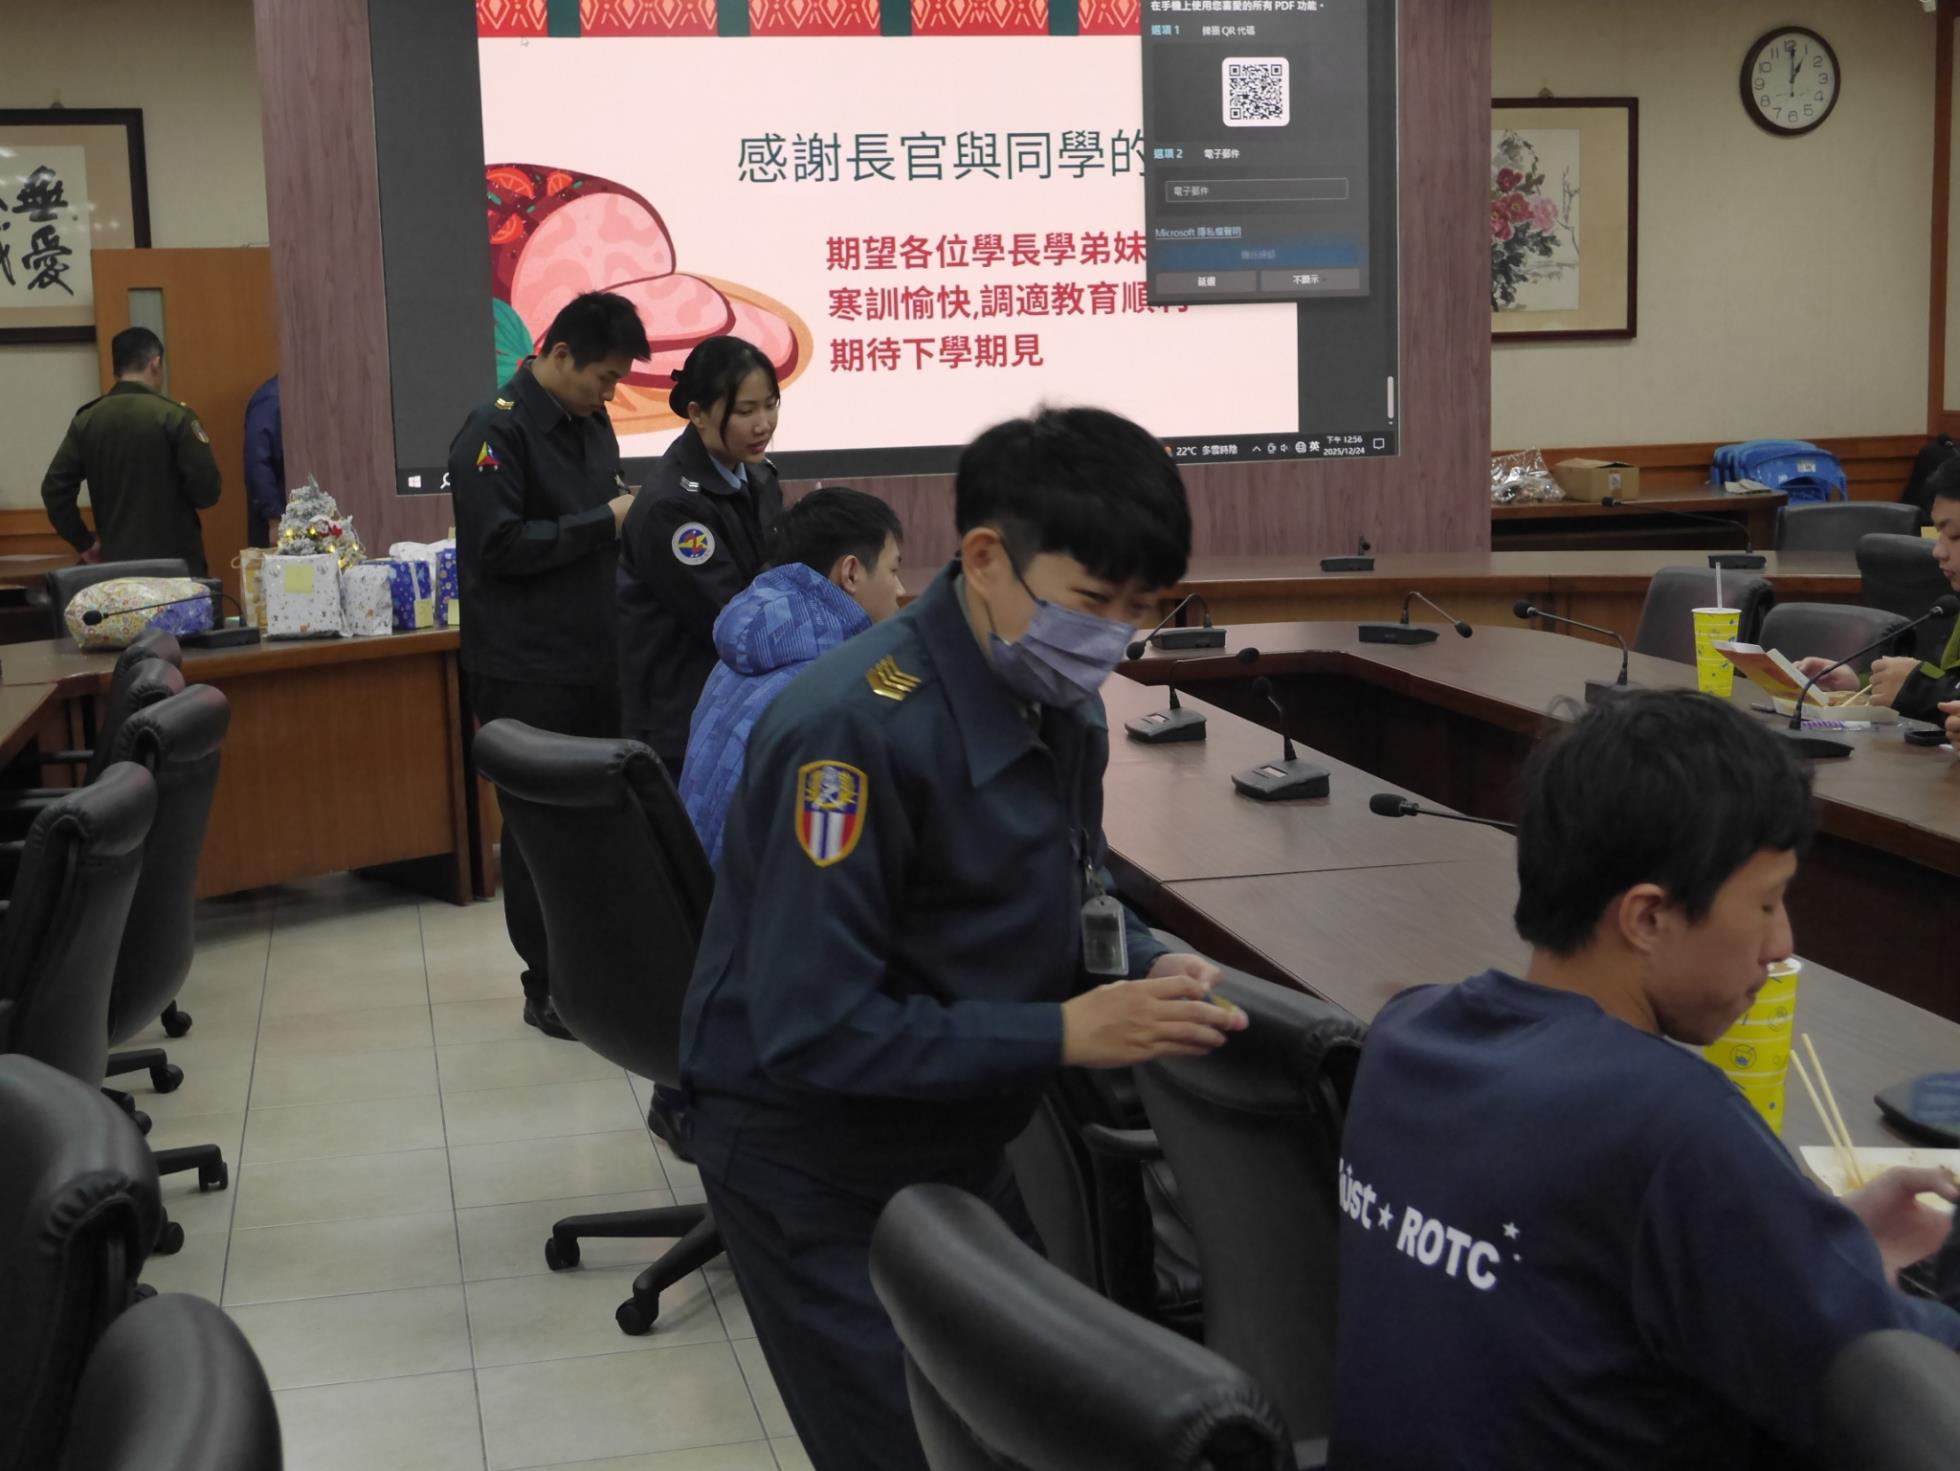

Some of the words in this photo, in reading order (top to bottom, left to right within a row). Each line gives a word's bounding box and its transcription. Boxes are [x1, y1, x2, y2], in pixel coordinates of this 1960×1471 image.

[1274, 1, 1295, 11] PDF
[1221, 26, 1236, 37] QR
[1770, 47, 1780, 59] 11
[1804, 43, 1809, 56] 1
[1760, 61, 1772, 73] 10
[1813, 56, 1824, 68] 2
[1754, 79, 1766, 91] 9
[1818, 73, 1829, 85] 3
[1760, 95, 1771, 108] 8
[1814, 91, 1824, 102] 4
[1772, 107, 1782, 120] 7
[1788, 110, 1798, 123] 6
[1803, 104, 1814, 117] 5
[738, 129, 1145, 184] 感謝長官與同學的
[1176, 149, 1183, 159] 2
[1155, 229, 1195, 238] Microsoft
[826, 231, 1147, 271] 期望各位學長學弟妹
[828, 281, 1188, 321] 寒訓愉快,調適教育順
[830, 334, 1044, 373] 期待下學期見
[1309, 441, 1321, 452] 英
[1323, 447, 1366, 456] 2025/12/24
[1397, 1205, 1501, 1291] ROTC
